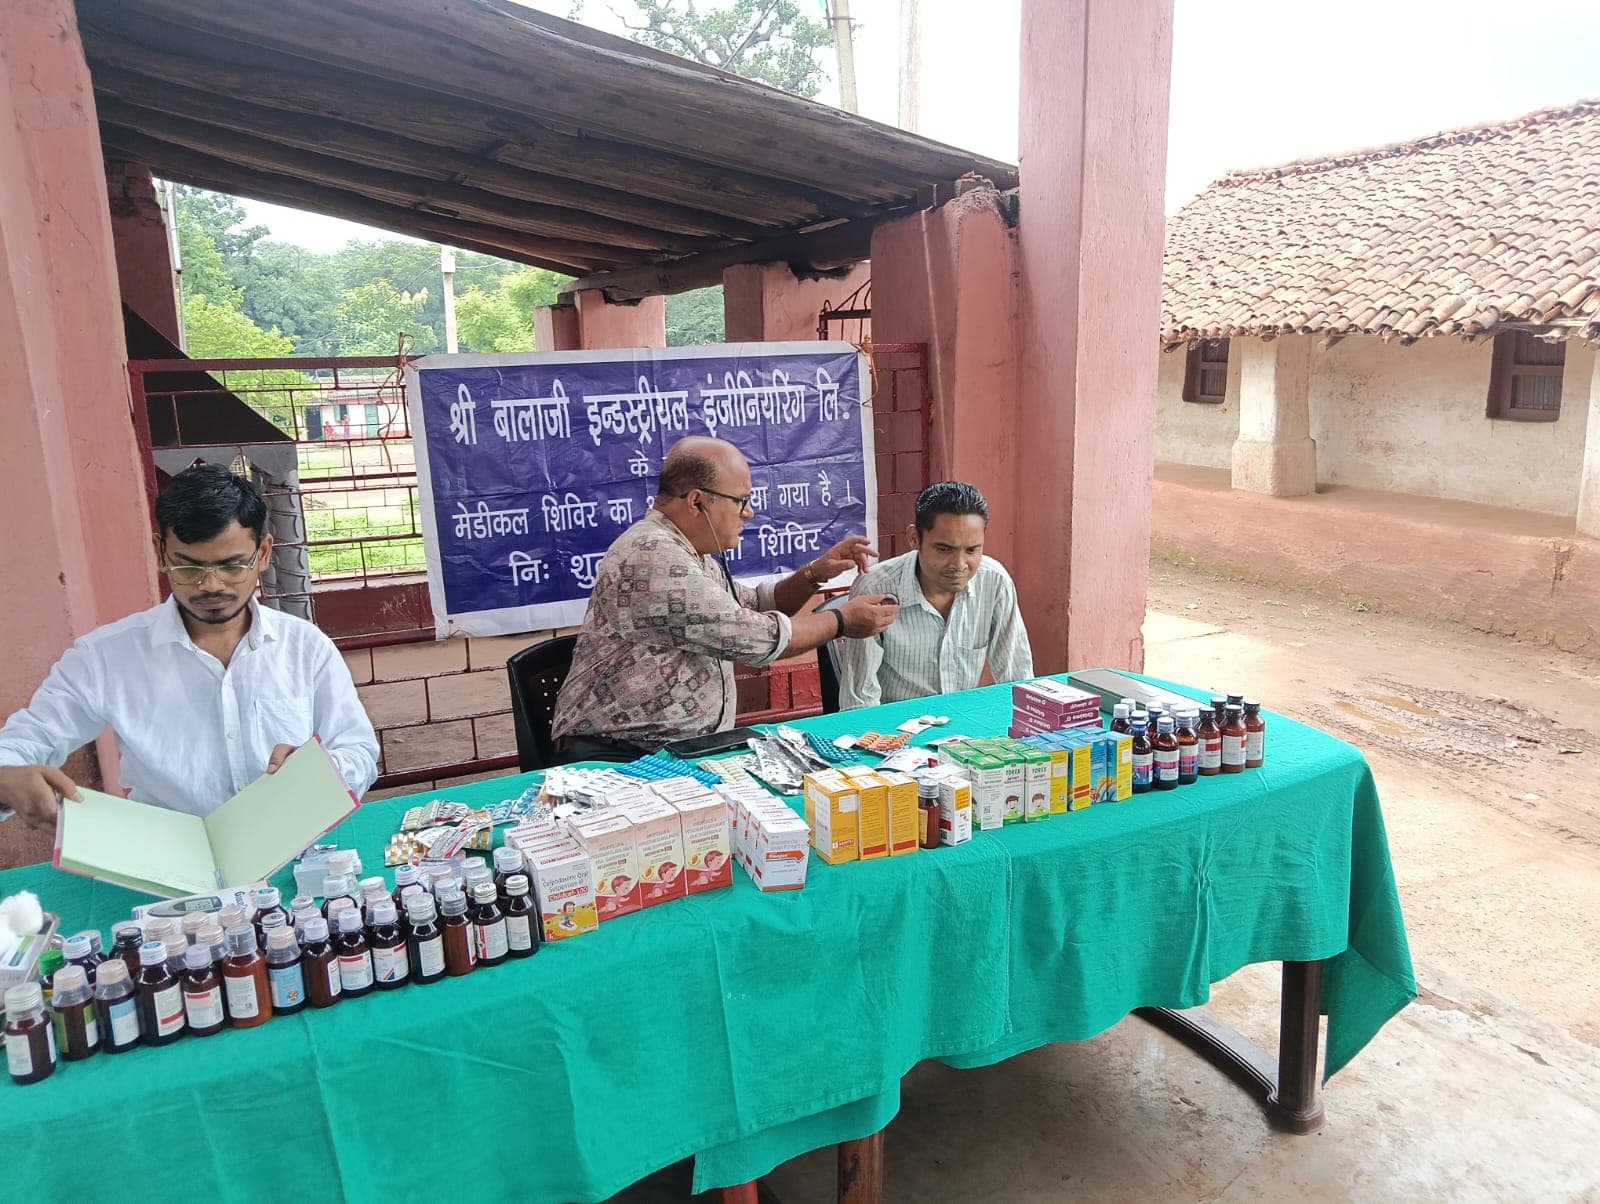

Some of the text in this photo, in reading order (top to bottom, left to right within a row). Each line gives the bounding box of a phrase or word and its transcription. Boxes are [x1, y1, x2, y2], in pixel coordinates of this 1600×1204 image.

[450, 383, 477, 445] श्री
[490, 379, 571, 442] बालाजी
[700, 369, 806, 438] इंजीनियरिंग
[628, 450, 649, 477] के
[452, 501, 529, 540] मेडीकल
[541, 492, 598, 532] शिविर
[608, 498, 633, 525] का
[778, 482, 810, 508] गया
[818, 470, 832, 506] है
[758, 521, 822, 557] शिविर
